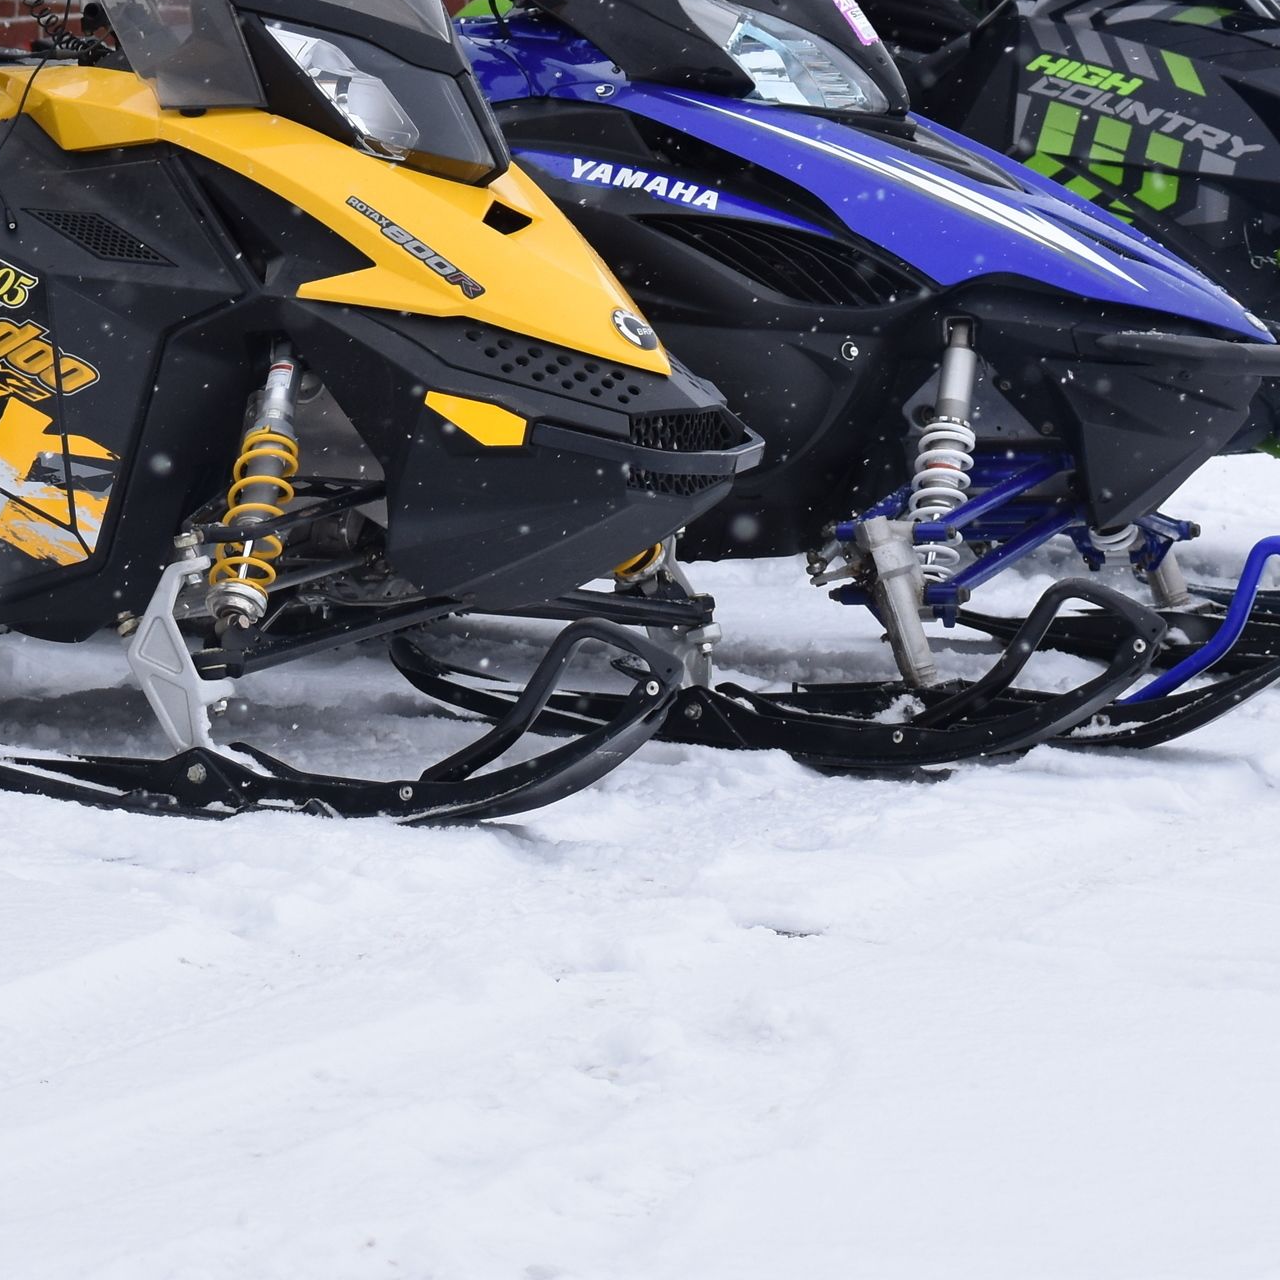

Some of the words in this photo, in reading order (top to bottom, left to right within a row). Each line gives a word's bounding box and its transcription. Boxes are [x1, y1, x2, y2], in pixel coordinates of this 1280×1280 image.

[1026, 54, 1143, 96] HIGH
[1027, 75, 1265, 158] COUNTRY
[571, 157, 719, 211] YAMAHA
[347, 195, 390, 227] ROTAX
[382, 224, 486, 299] 800R
